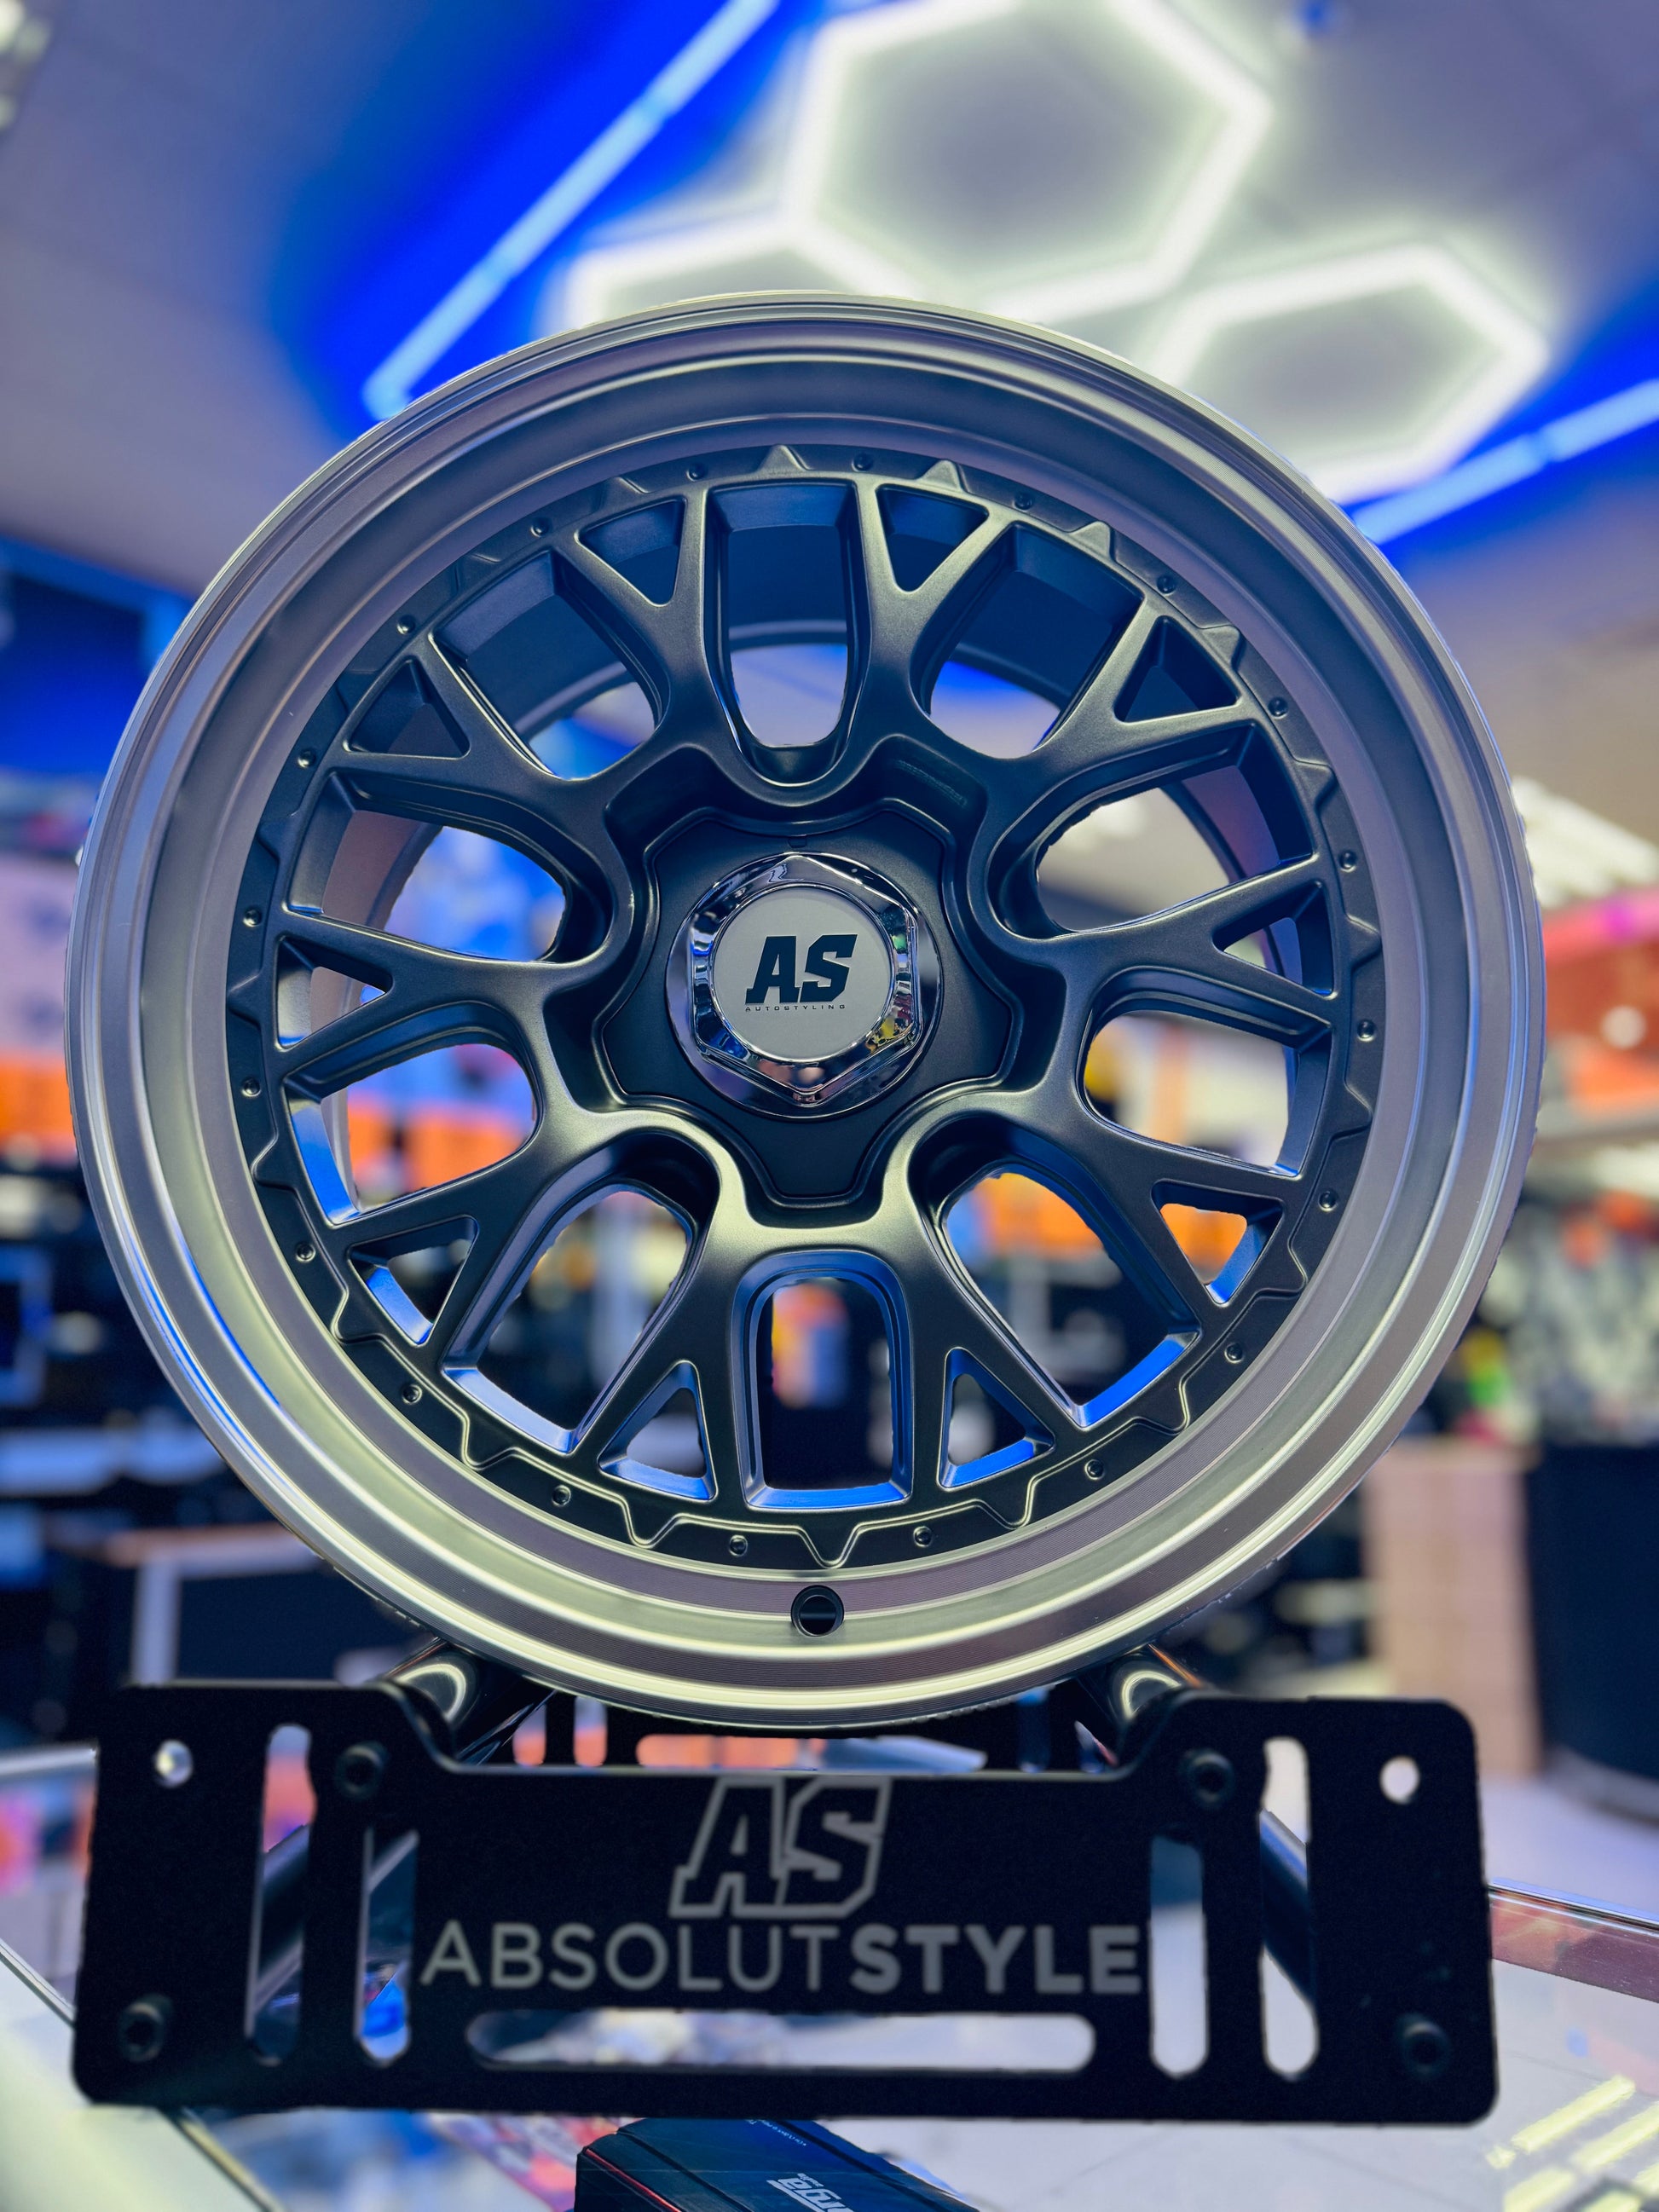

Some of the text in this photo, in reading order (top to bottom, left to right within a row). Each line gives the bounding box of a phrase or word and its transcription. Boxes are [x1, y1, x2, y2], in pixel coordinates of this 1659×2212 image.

[745, 933, 858, 1004] AS
[668, 1775, 893, 1918] AS
[419, 1919, 1142, 1992] ABSOLUTSTYLE
